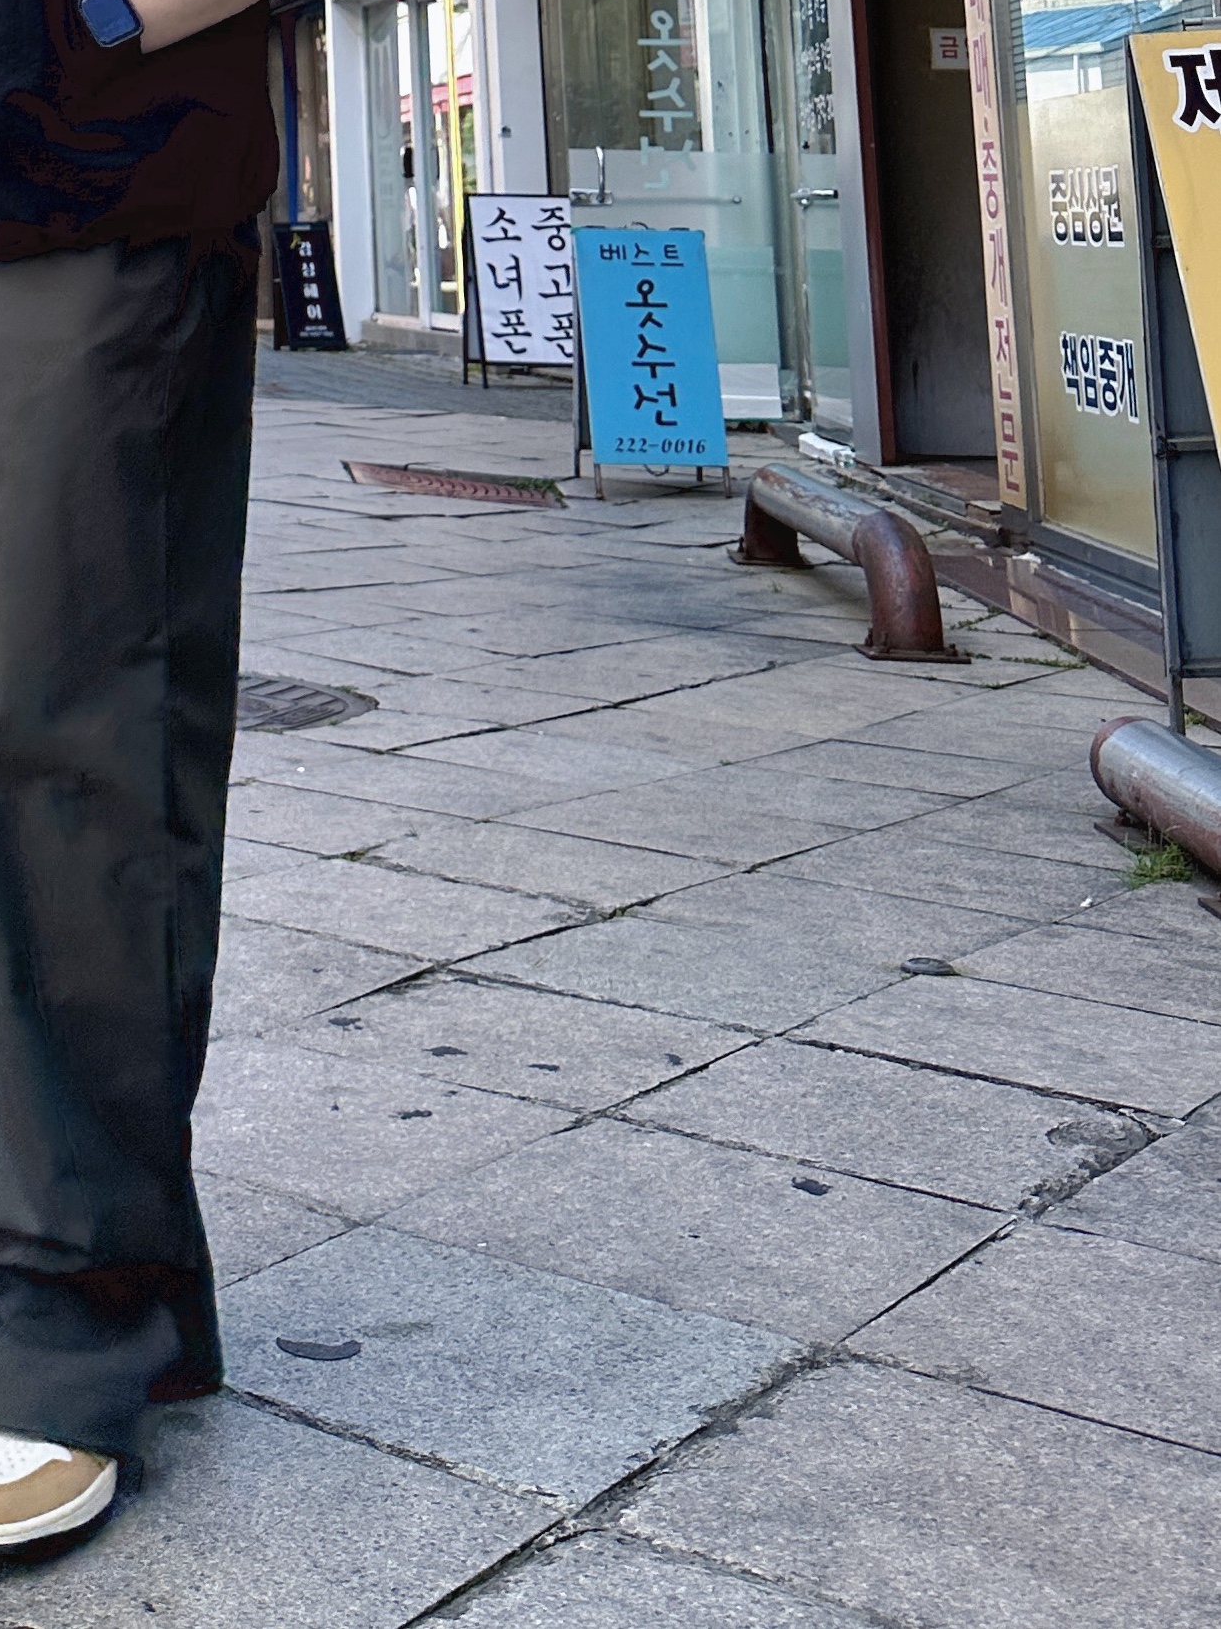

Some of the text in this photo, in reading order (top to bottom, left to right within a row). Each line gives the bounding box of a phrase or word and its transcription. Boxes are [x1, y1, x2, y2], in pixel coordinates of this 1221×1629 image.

[1050, 168, 1125, 246] 중심상권
[531, 206, 575, 358] 중고폰
[600, 243, 684, 267] 베스트
[625, 279, 678, 427] 옷수선
[1060, 331, 1139, 424] 책임중개
[615, 437, 706, 454] 222-0016
